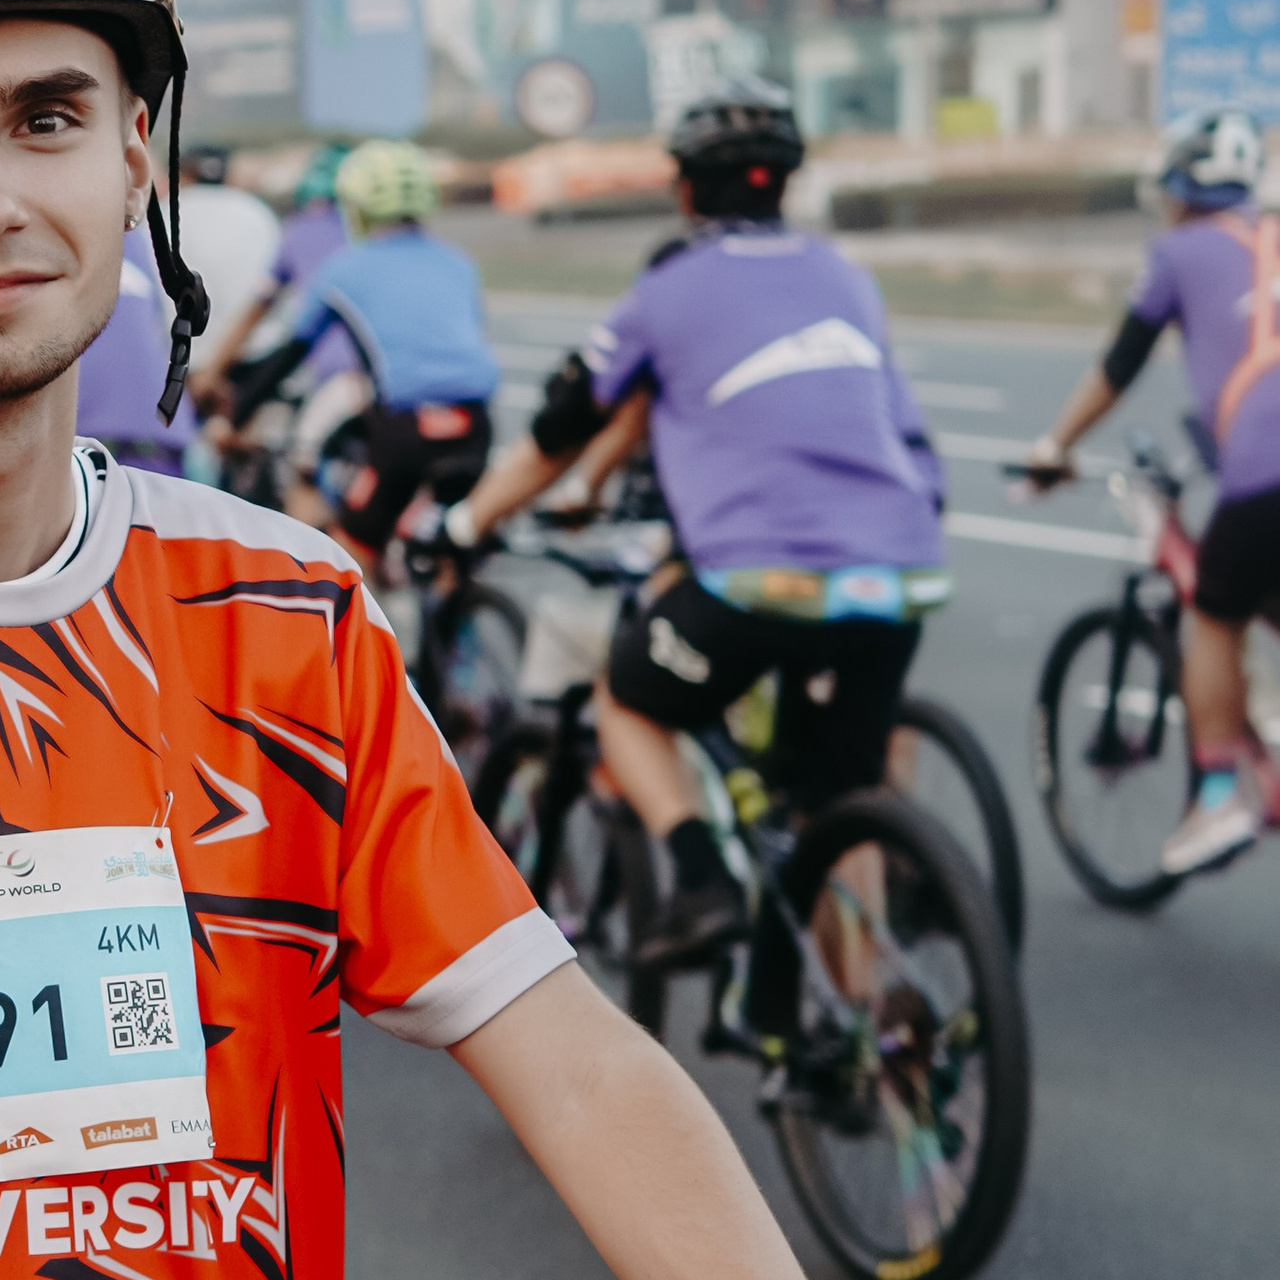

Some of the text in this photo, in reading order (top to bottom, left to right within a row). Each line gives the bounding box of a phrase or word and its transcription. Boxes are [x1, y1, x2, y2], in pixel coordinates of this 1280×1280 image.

[8, 882, 62, 897] WORLD
[97, 923, 160, 954] 4KM
[6, 1134, 41, 1149] RTA
[87, 1122, 152, 1144] talabat
